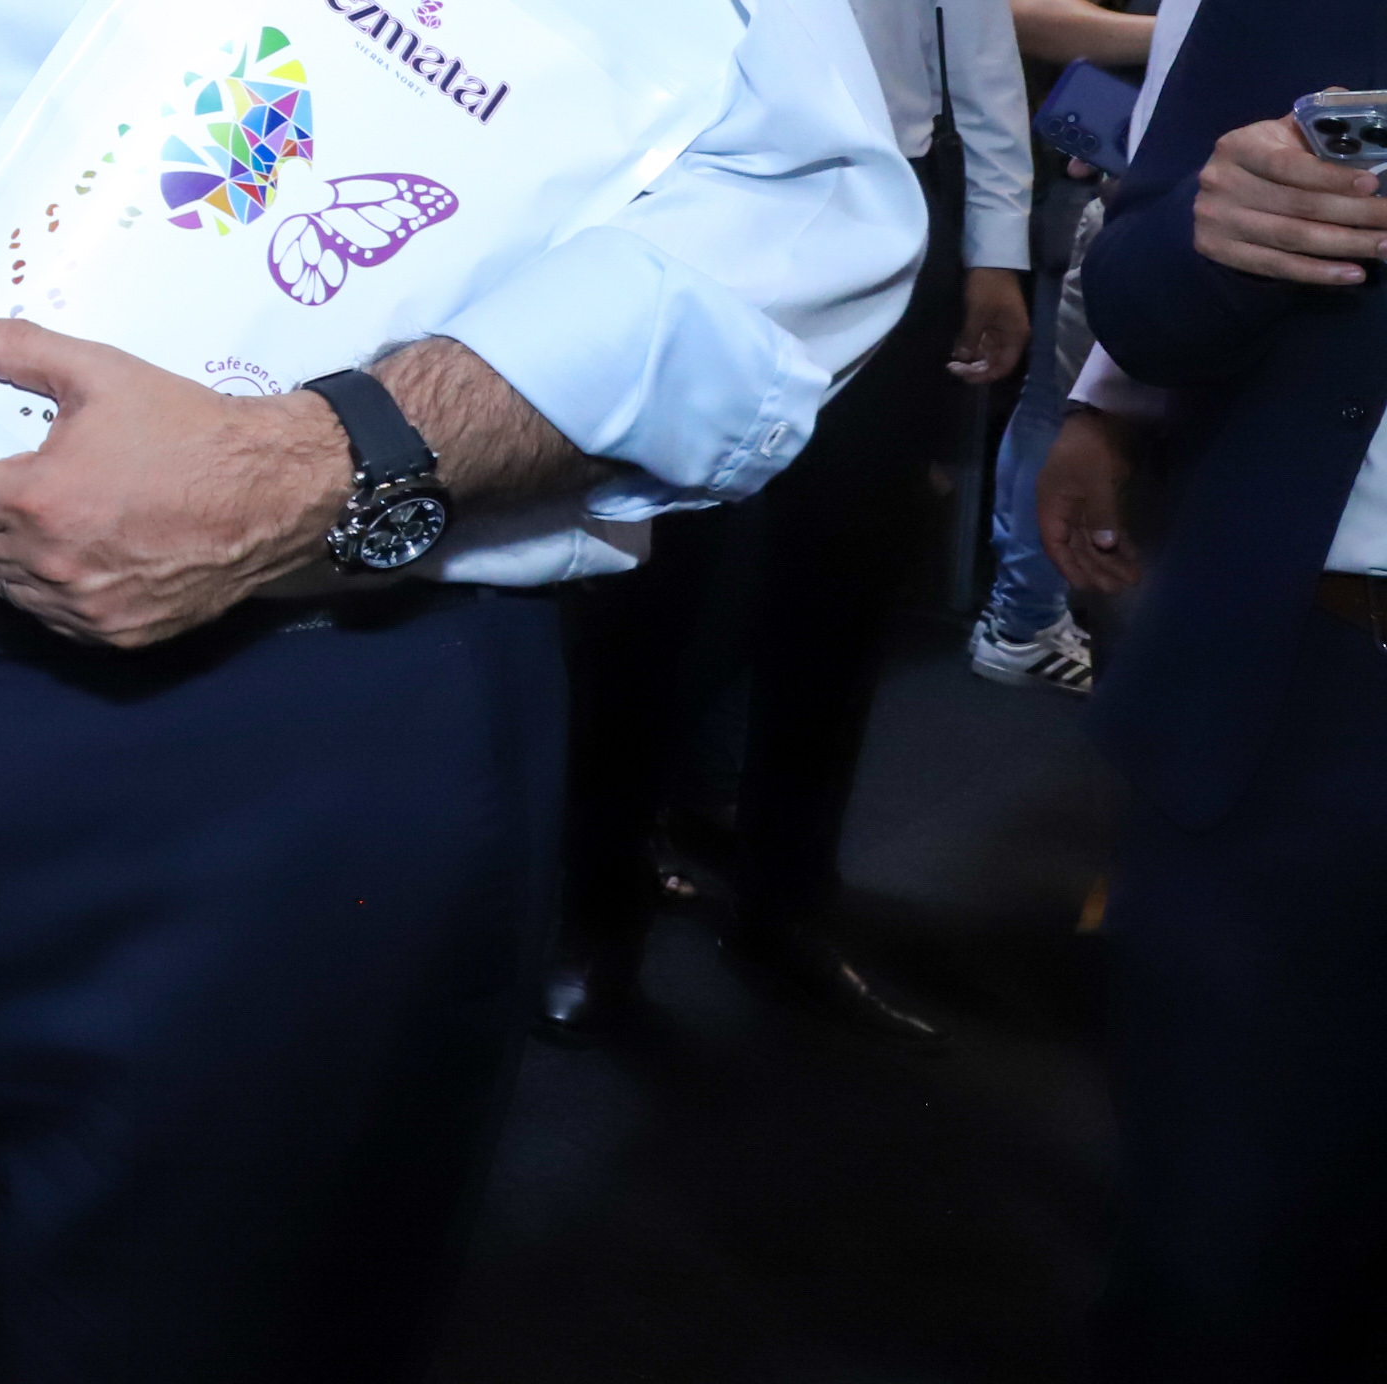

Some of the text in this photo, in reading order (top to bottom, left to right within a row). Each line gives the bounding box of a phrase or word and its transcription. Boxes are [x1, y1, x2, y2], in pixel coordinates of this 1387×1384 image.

[354, 41, 426, 98] SIERRA NORTE
[244, 362, 269, 380] con
